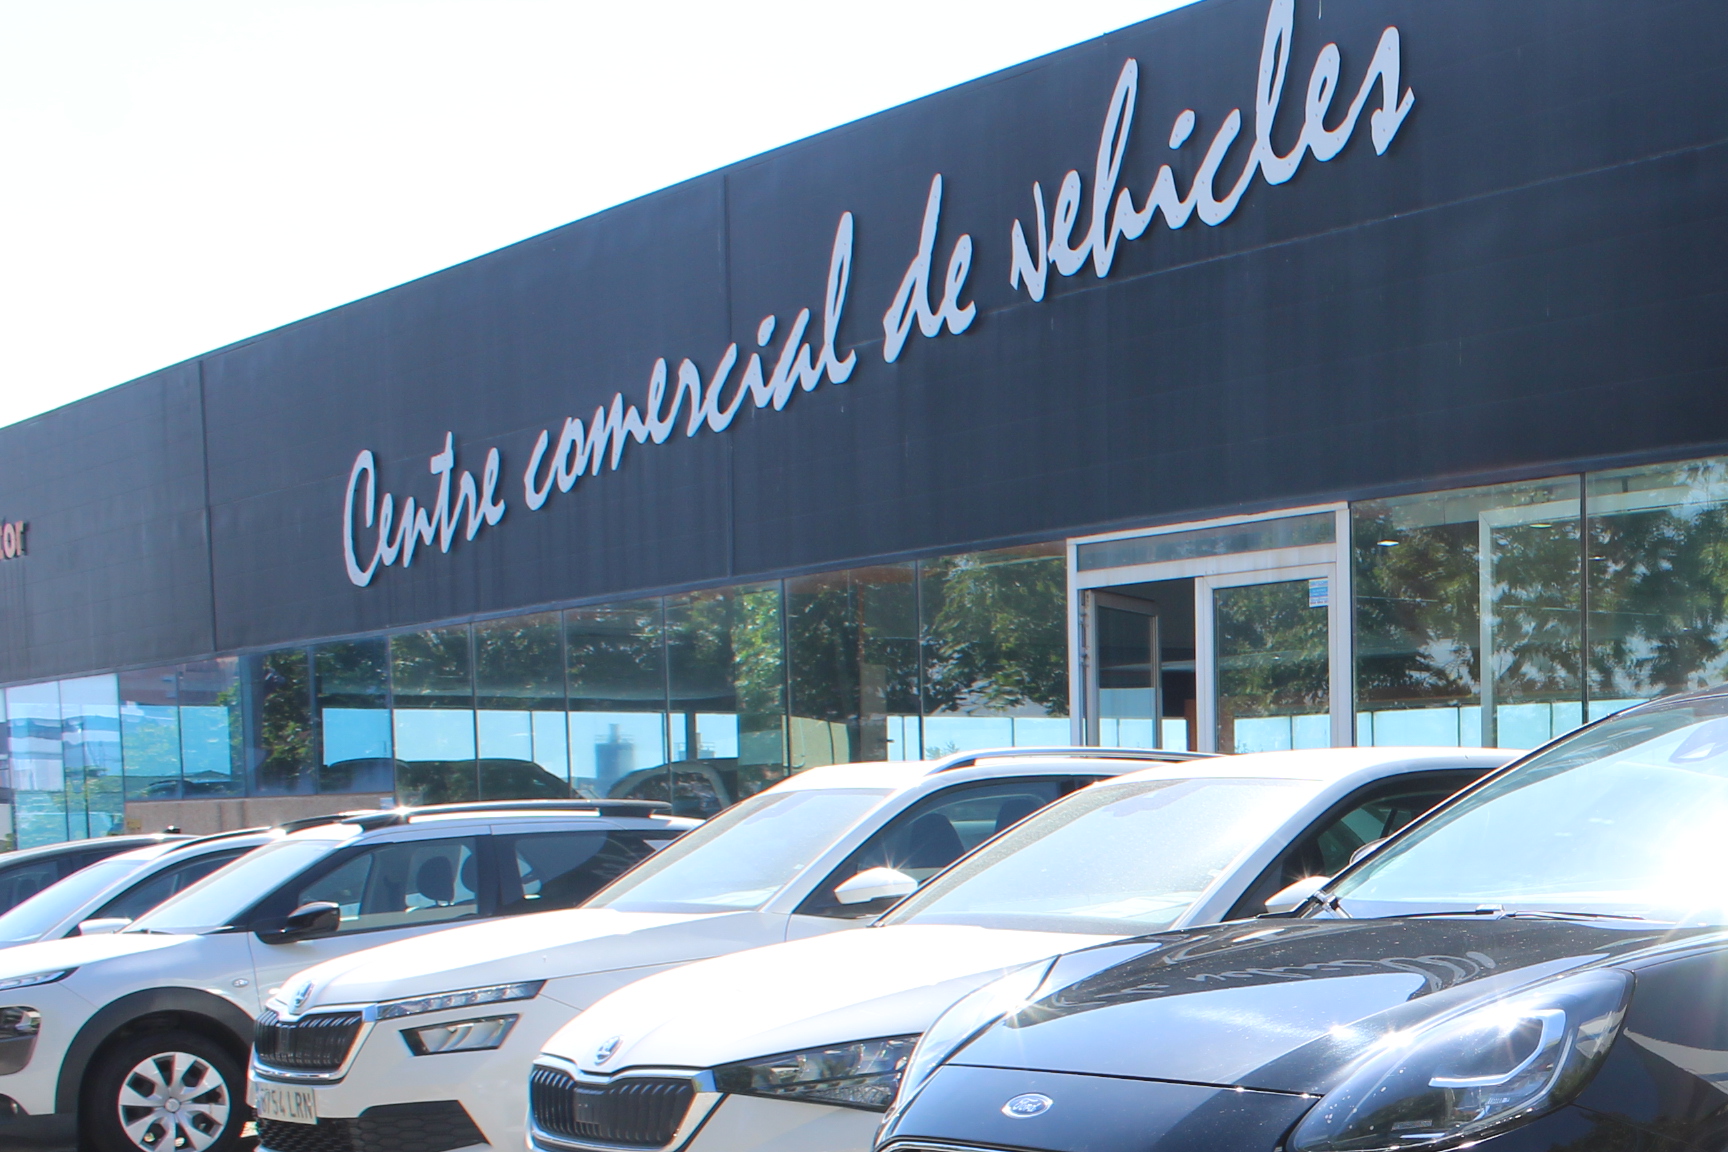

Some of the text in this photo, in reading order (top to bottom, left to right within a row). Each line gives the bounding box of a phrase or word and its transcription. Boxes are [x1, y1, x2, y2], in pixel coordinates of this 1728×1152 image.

[343, 0, 1415, 586] Centre comercial de vehicles
[0, 520, 24, 560] or
[287, 1091, 313, 1119] LRN
